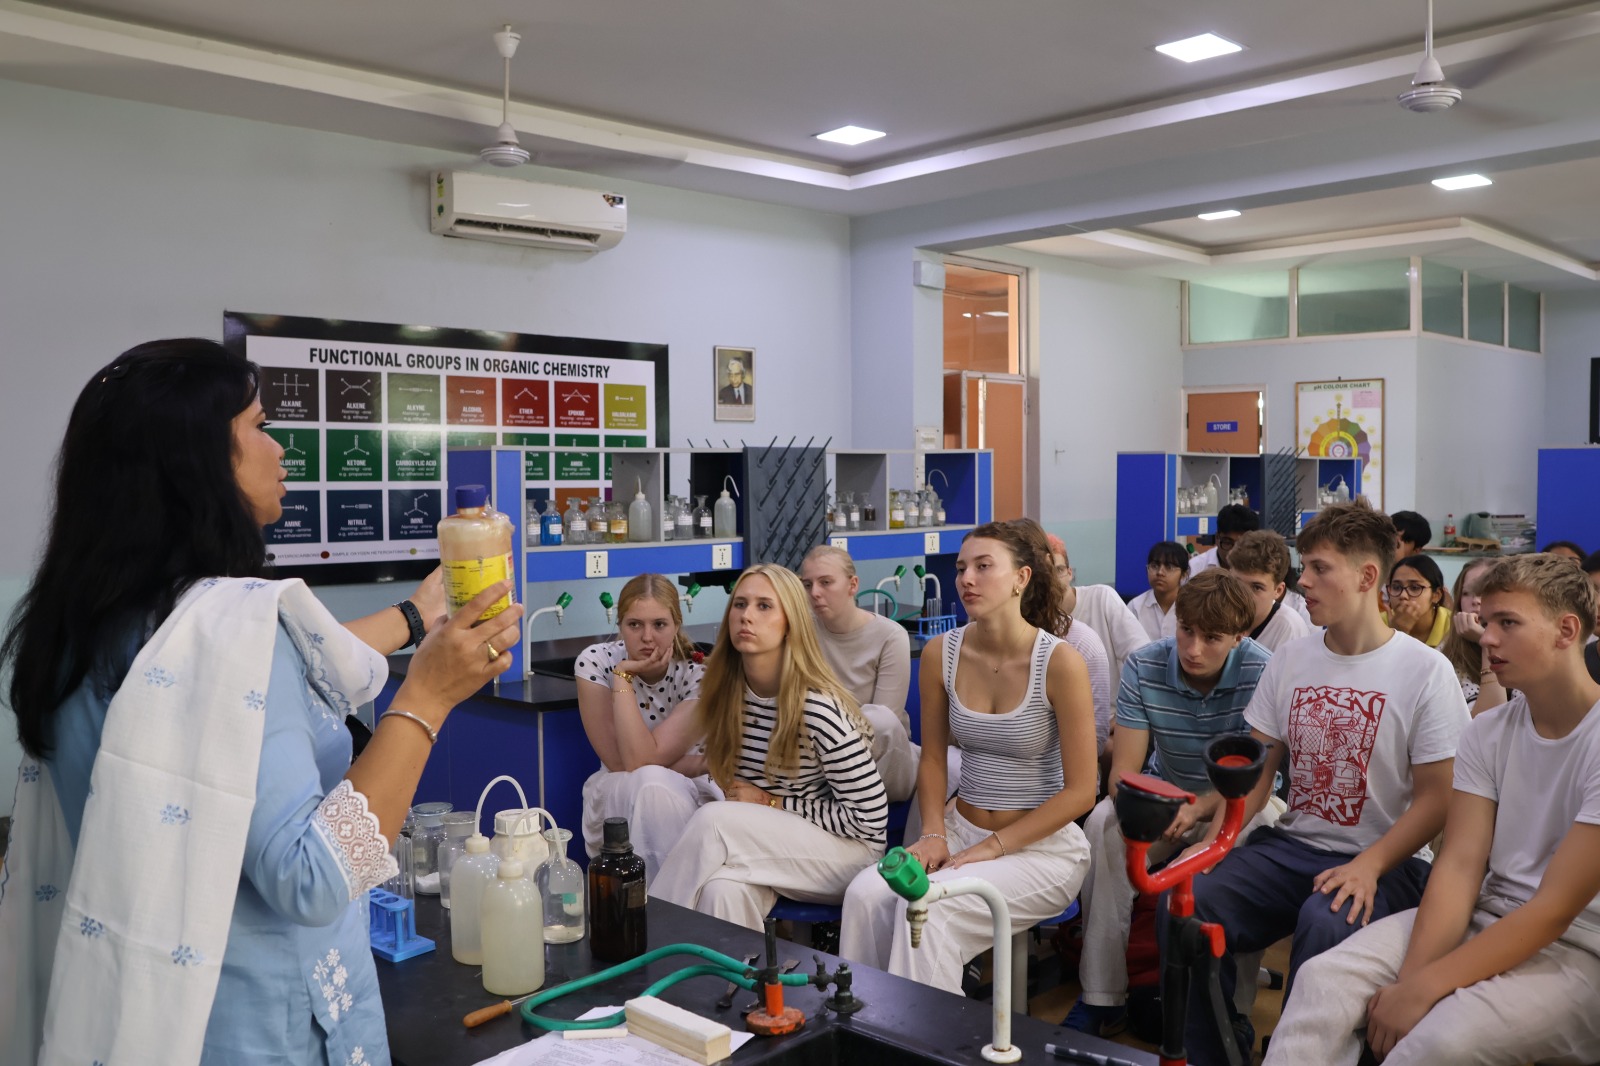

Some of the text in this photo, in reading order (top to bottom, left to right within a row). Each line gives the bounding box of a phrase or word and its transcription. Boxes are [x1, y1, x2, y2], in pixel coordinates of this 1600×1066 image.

[309, 347, 610, 379] FUNCTIONAL GROUPS IN ORGANIC CHEMISTRY
[280, 400, 302, 408] ALKANE
[346, 402, 366, 410] ALKENE
[406, 404, 425, 412] ALKYNE
[1213, 423, 1231, 431] STORE
[346, 459, 366, 467] KETONE
[284, 520, 302, 528] AMINE
